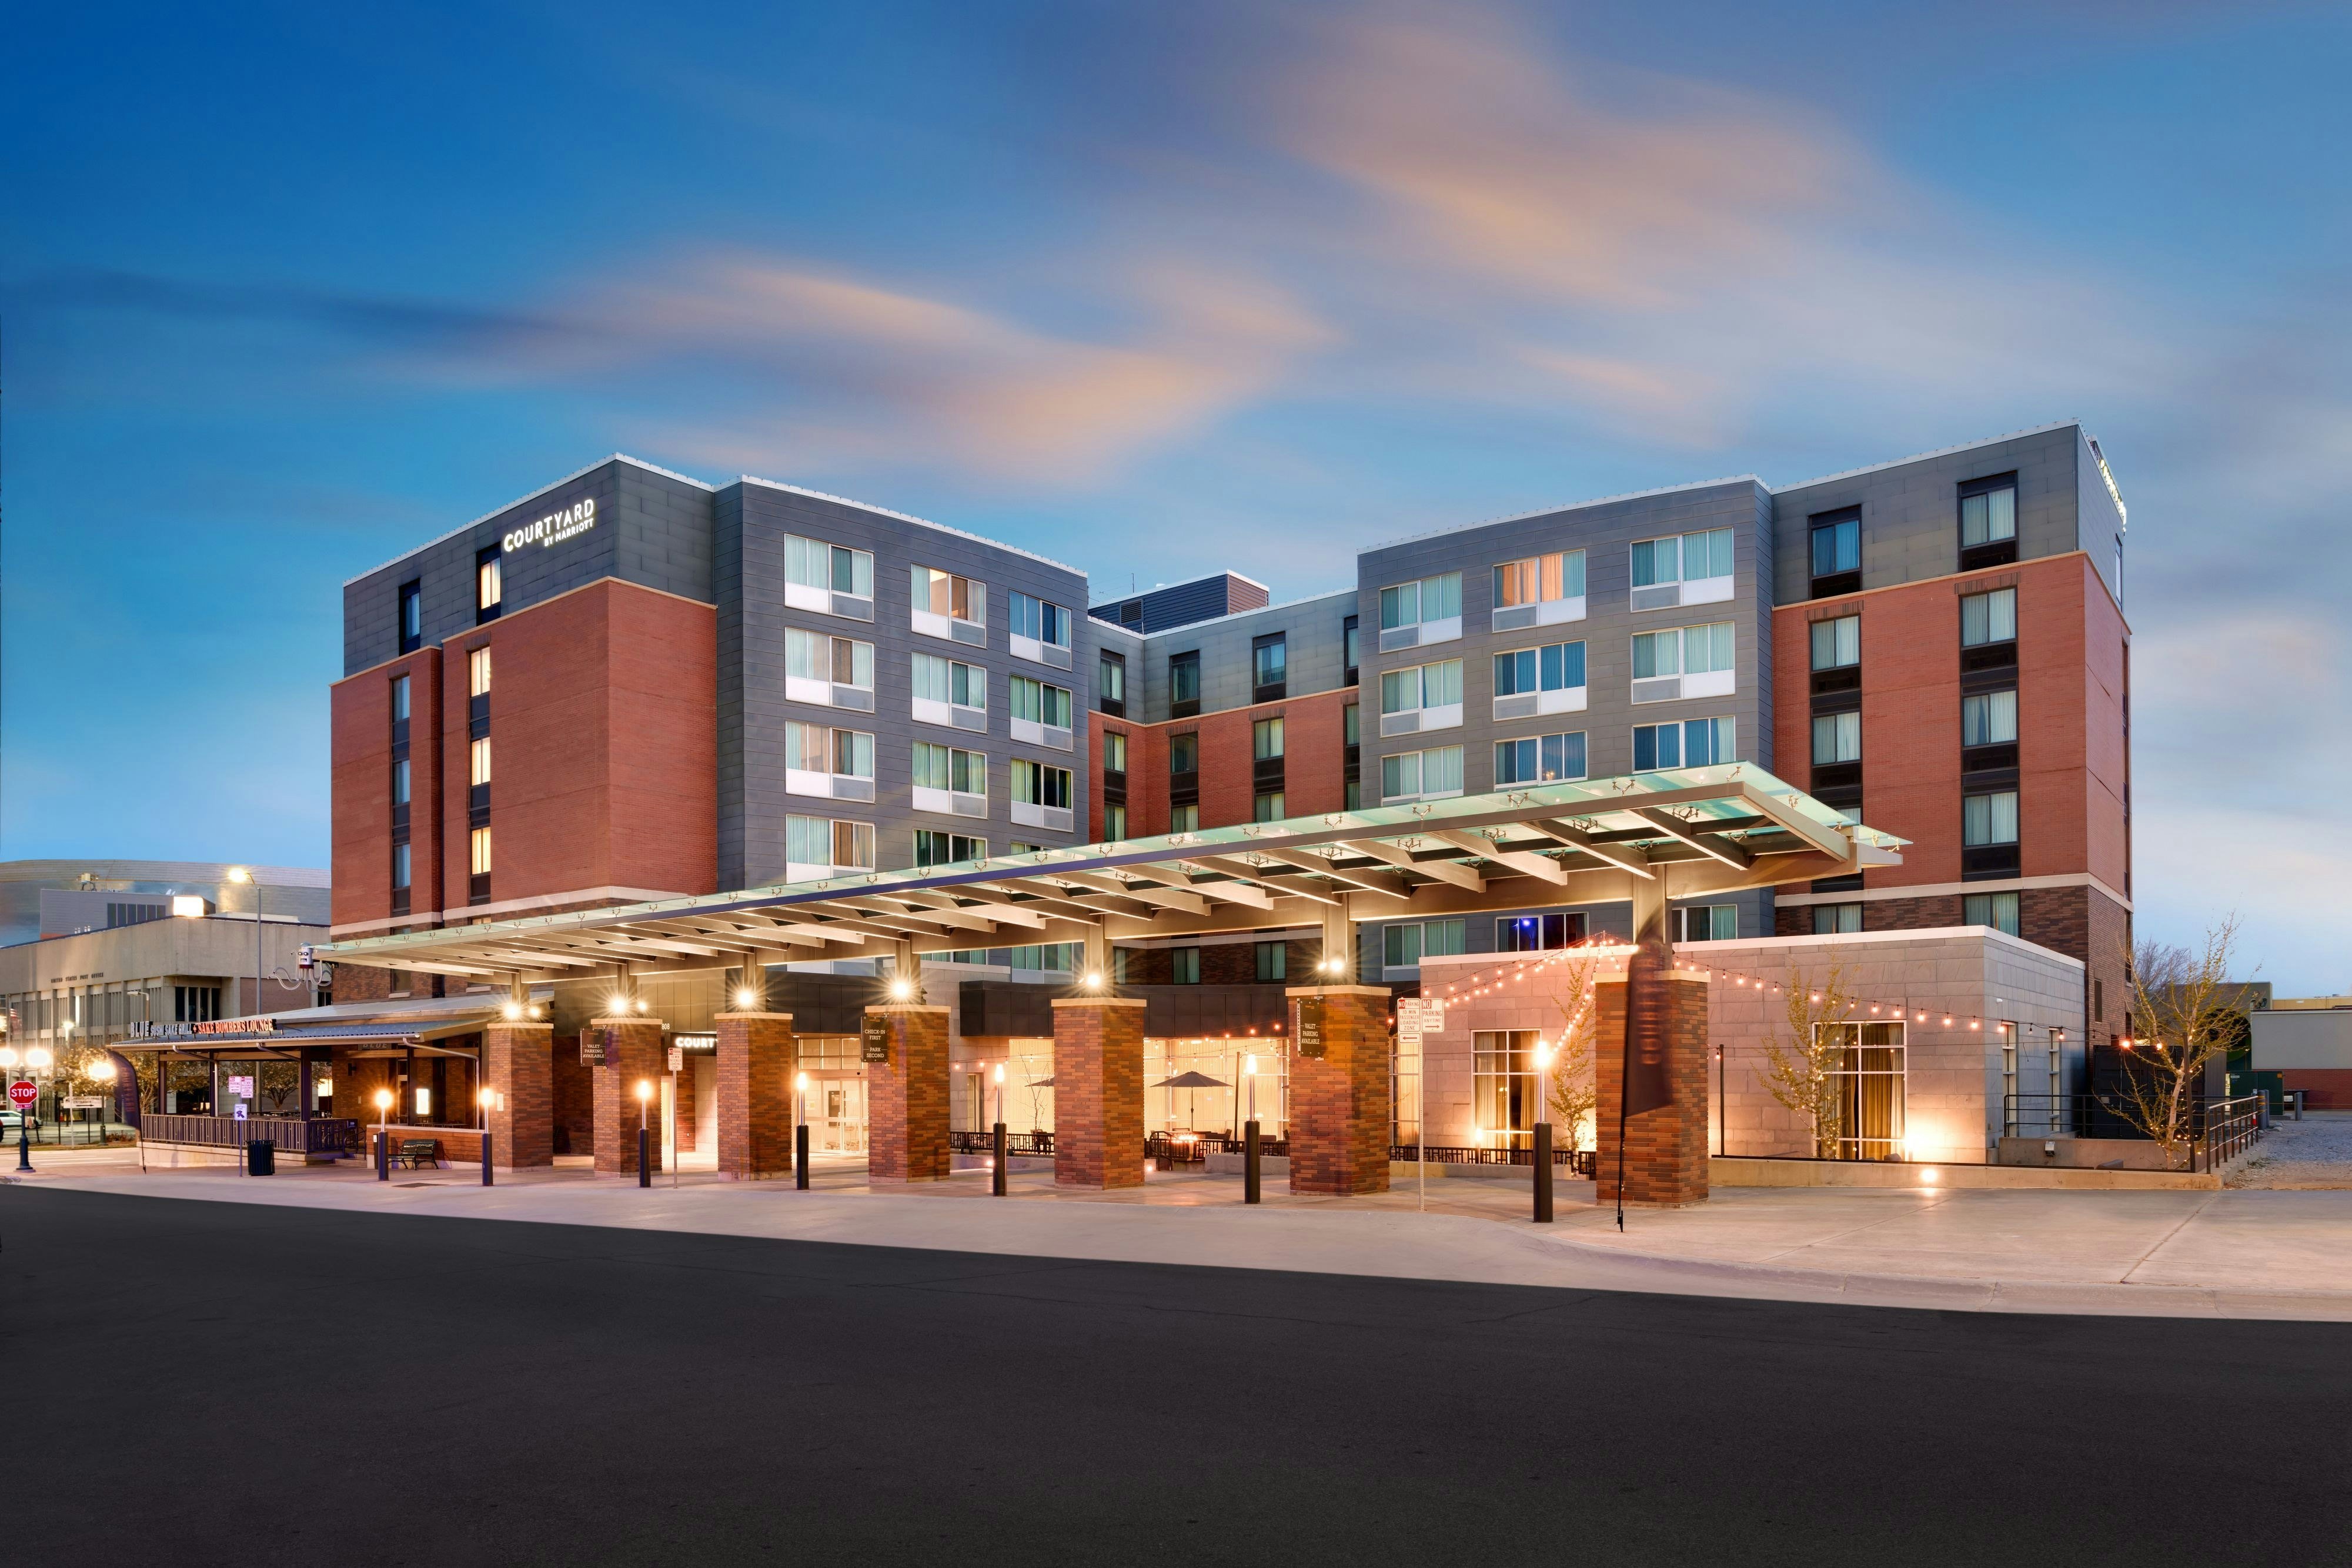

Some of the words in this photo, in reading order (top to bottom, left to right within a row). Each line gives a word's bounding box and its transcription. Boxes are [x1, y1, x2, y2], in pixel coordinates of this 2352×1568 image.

[504, 499, 594, 552] COURTYARD
[544, 536, 553, 547] BY
[555, 518, 594, 542] MARRIOTT
[1422, 999, 1431, 1009] NO
[130, 1021, 150, 1038] BLUE
[150, 1025, 165, 1037] SUSHI
[165, 1024, 178, 1036] SAKE
[178, 1023, 192, 1035] GRILL
[198, 1022, 215, 1034] SAKE
[215, 1021, 246, 1034] BOMBERS
[246, 1018, 273, 1032] LOUNGE
[675, 1037, 717, 1048] COURT
[11, 1088, 36, 1097] STOP
